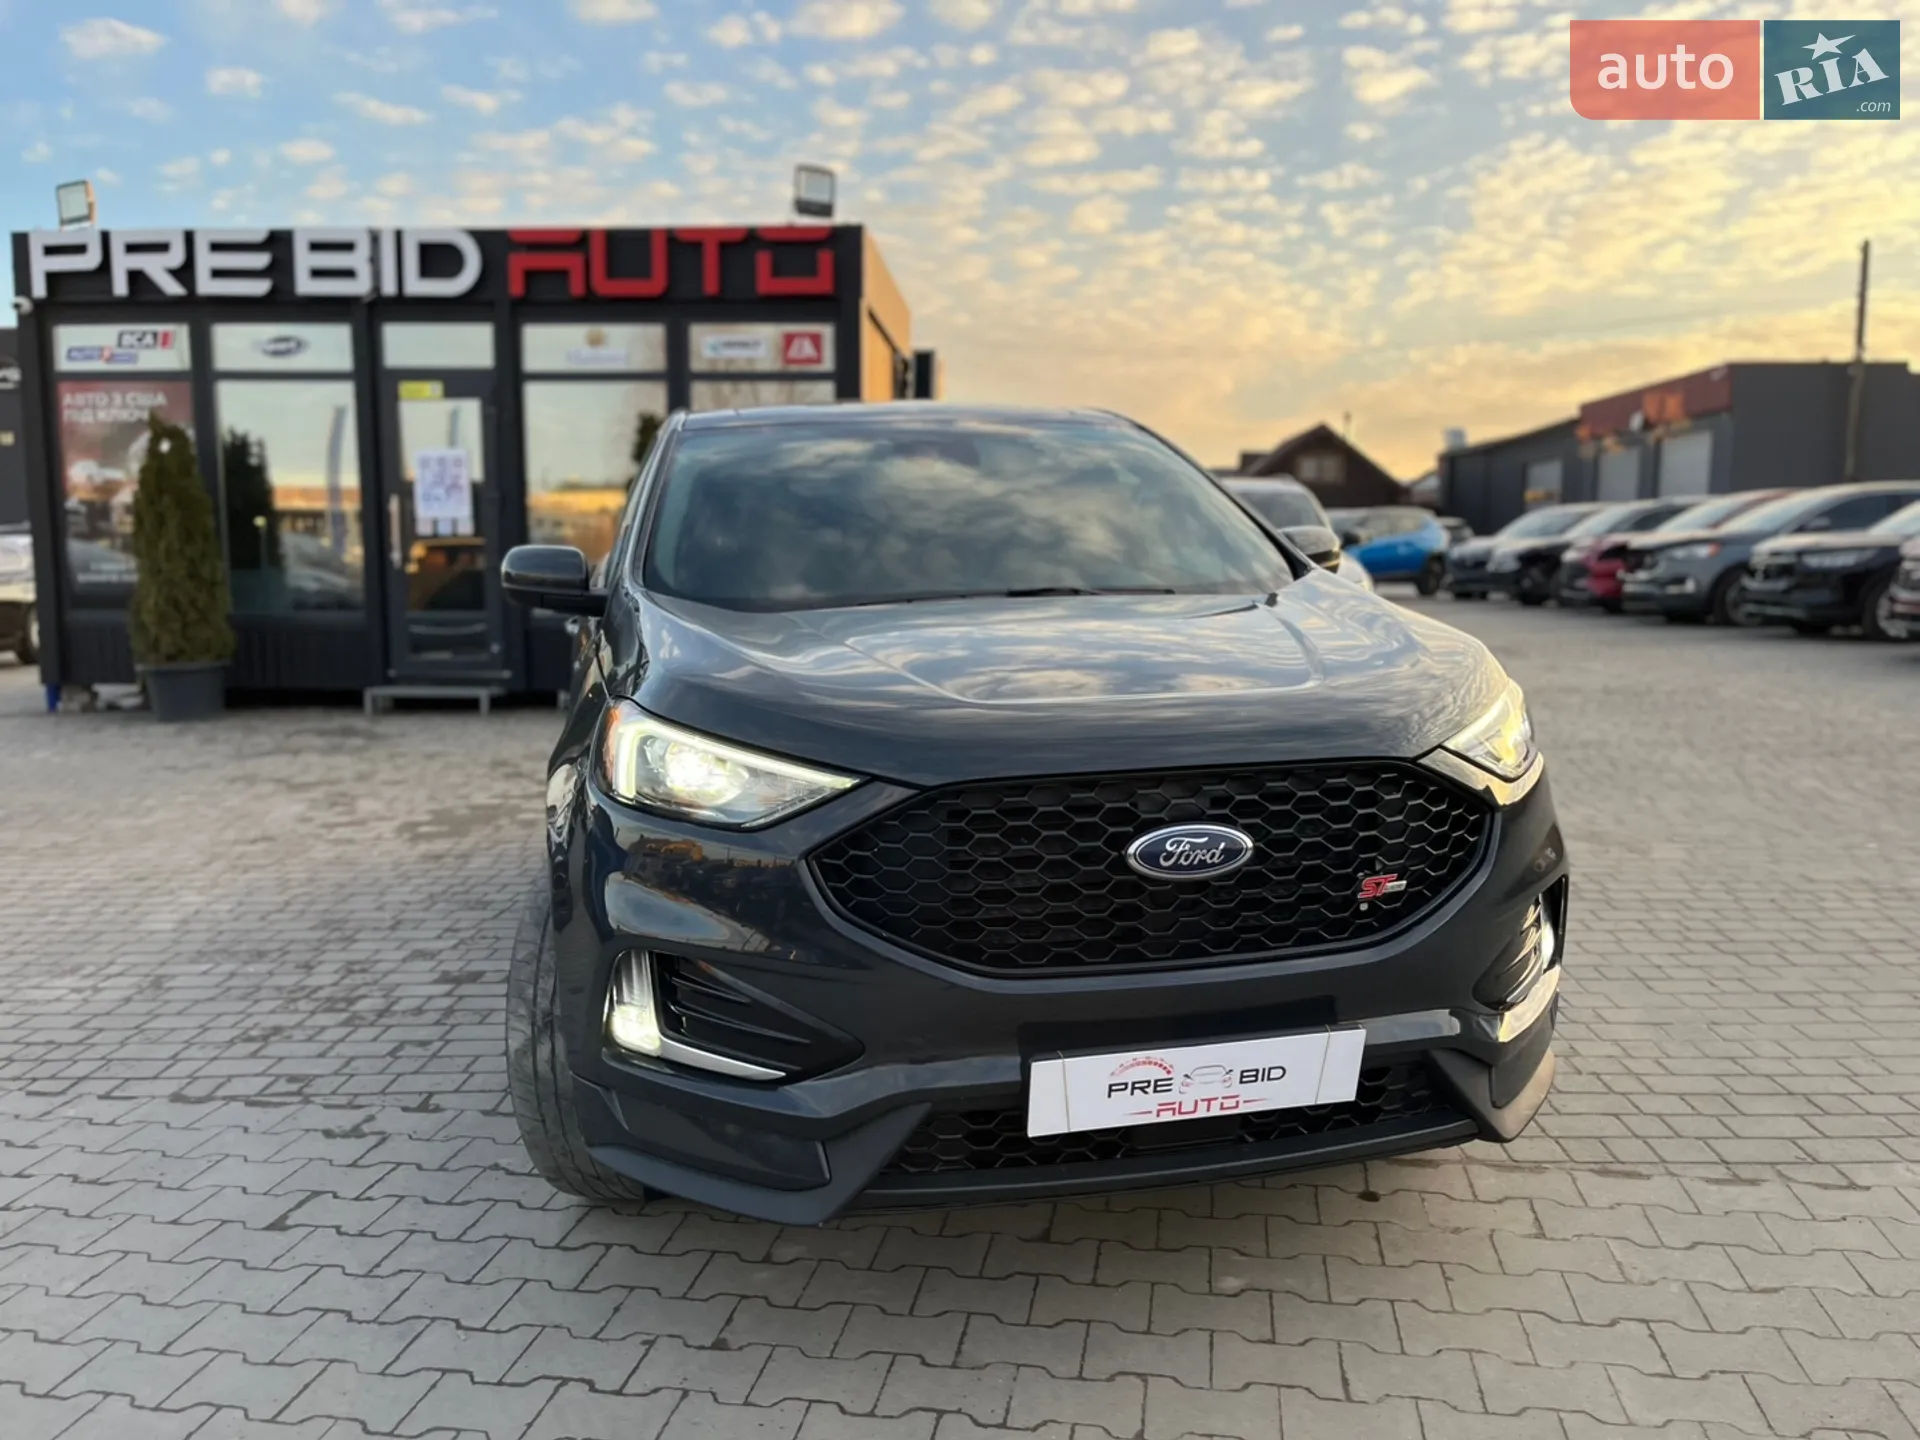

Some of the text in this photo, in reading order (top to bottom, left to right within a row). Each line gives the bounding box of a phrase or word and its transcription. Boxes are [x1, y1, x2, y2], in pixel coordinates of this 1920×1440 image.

[28, 228, 834, 298] PRE BID AUTO
[1159, 837, 1225, 867] Ford
[1358, 873, 1399, 899] ST
[1107, 1065, 1287, 1099] PRE BID
[1156, 1094, 1241, 1118] AUTO
